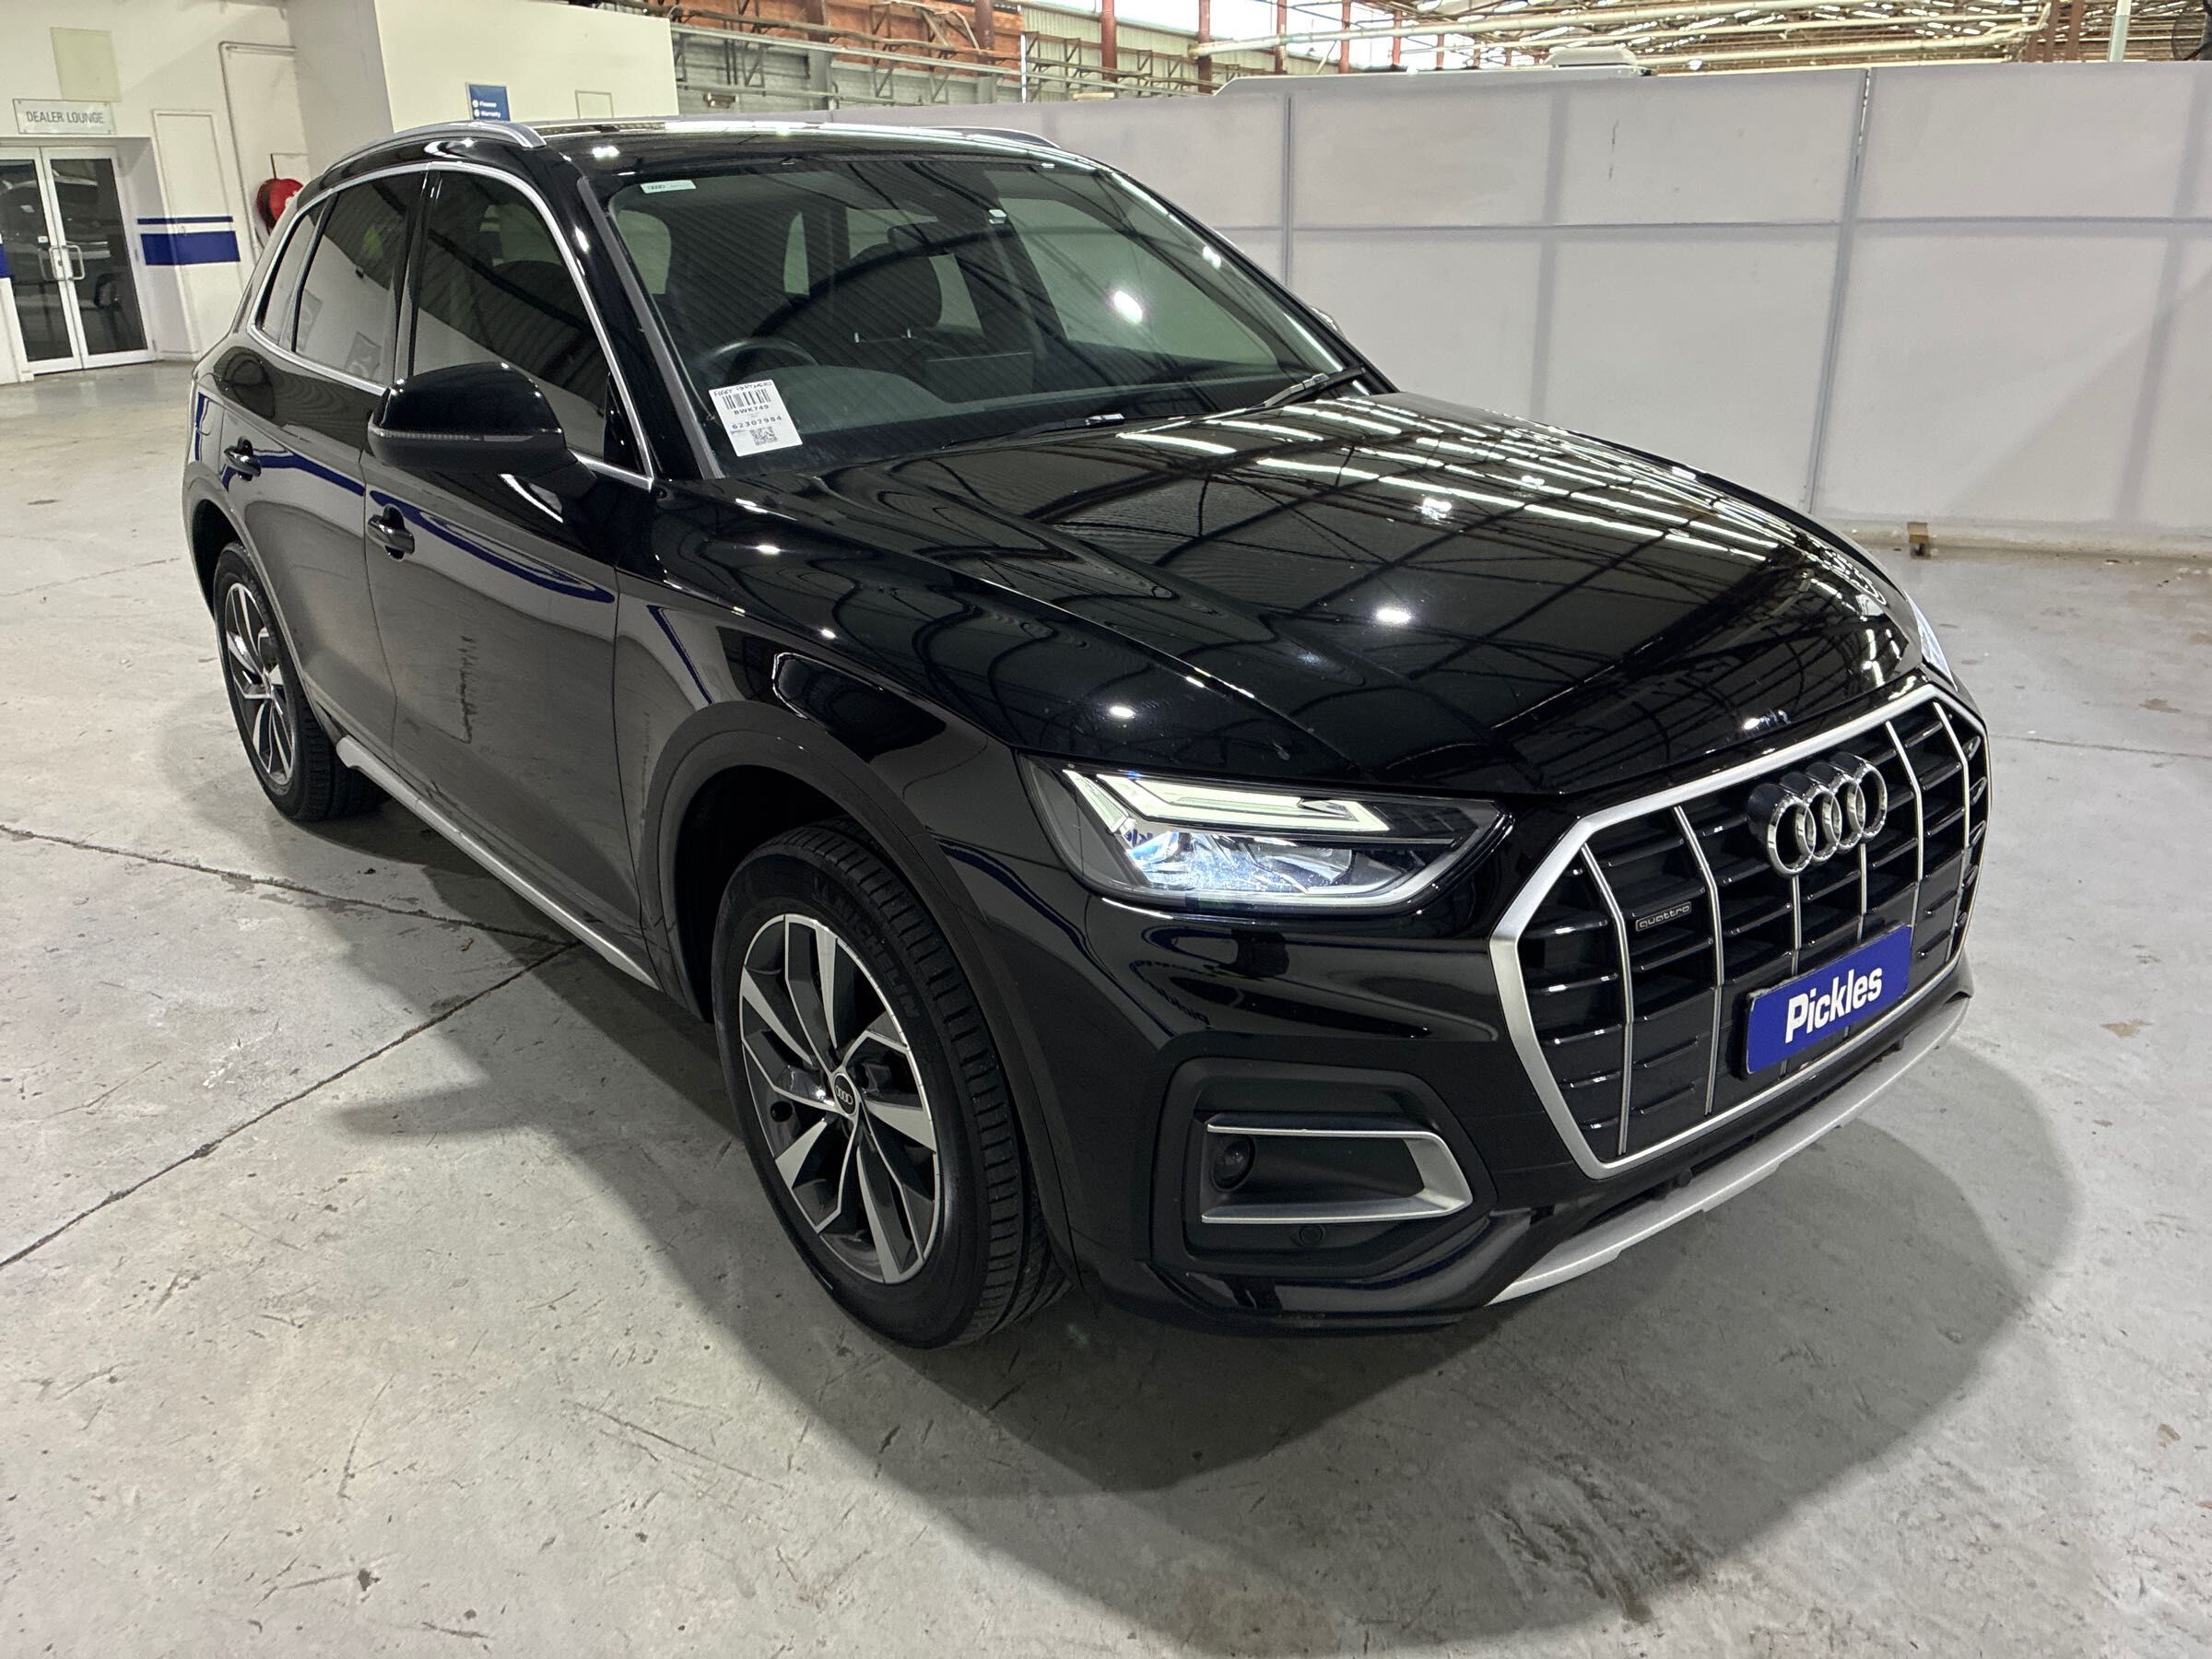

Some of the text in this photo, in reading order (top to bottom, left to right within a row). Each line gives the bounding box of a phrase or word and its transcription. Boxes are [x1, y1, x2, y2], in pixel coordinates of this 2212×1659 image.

[26, 111, 104, 124] DEALER LOUNGE
[734, 404, 770, 415] BWK749
[732, 415, 782, 429] 62307984
[1639, 905, 1690, 928] quattro
[1784, 967, 1883, 1044] Pickles
